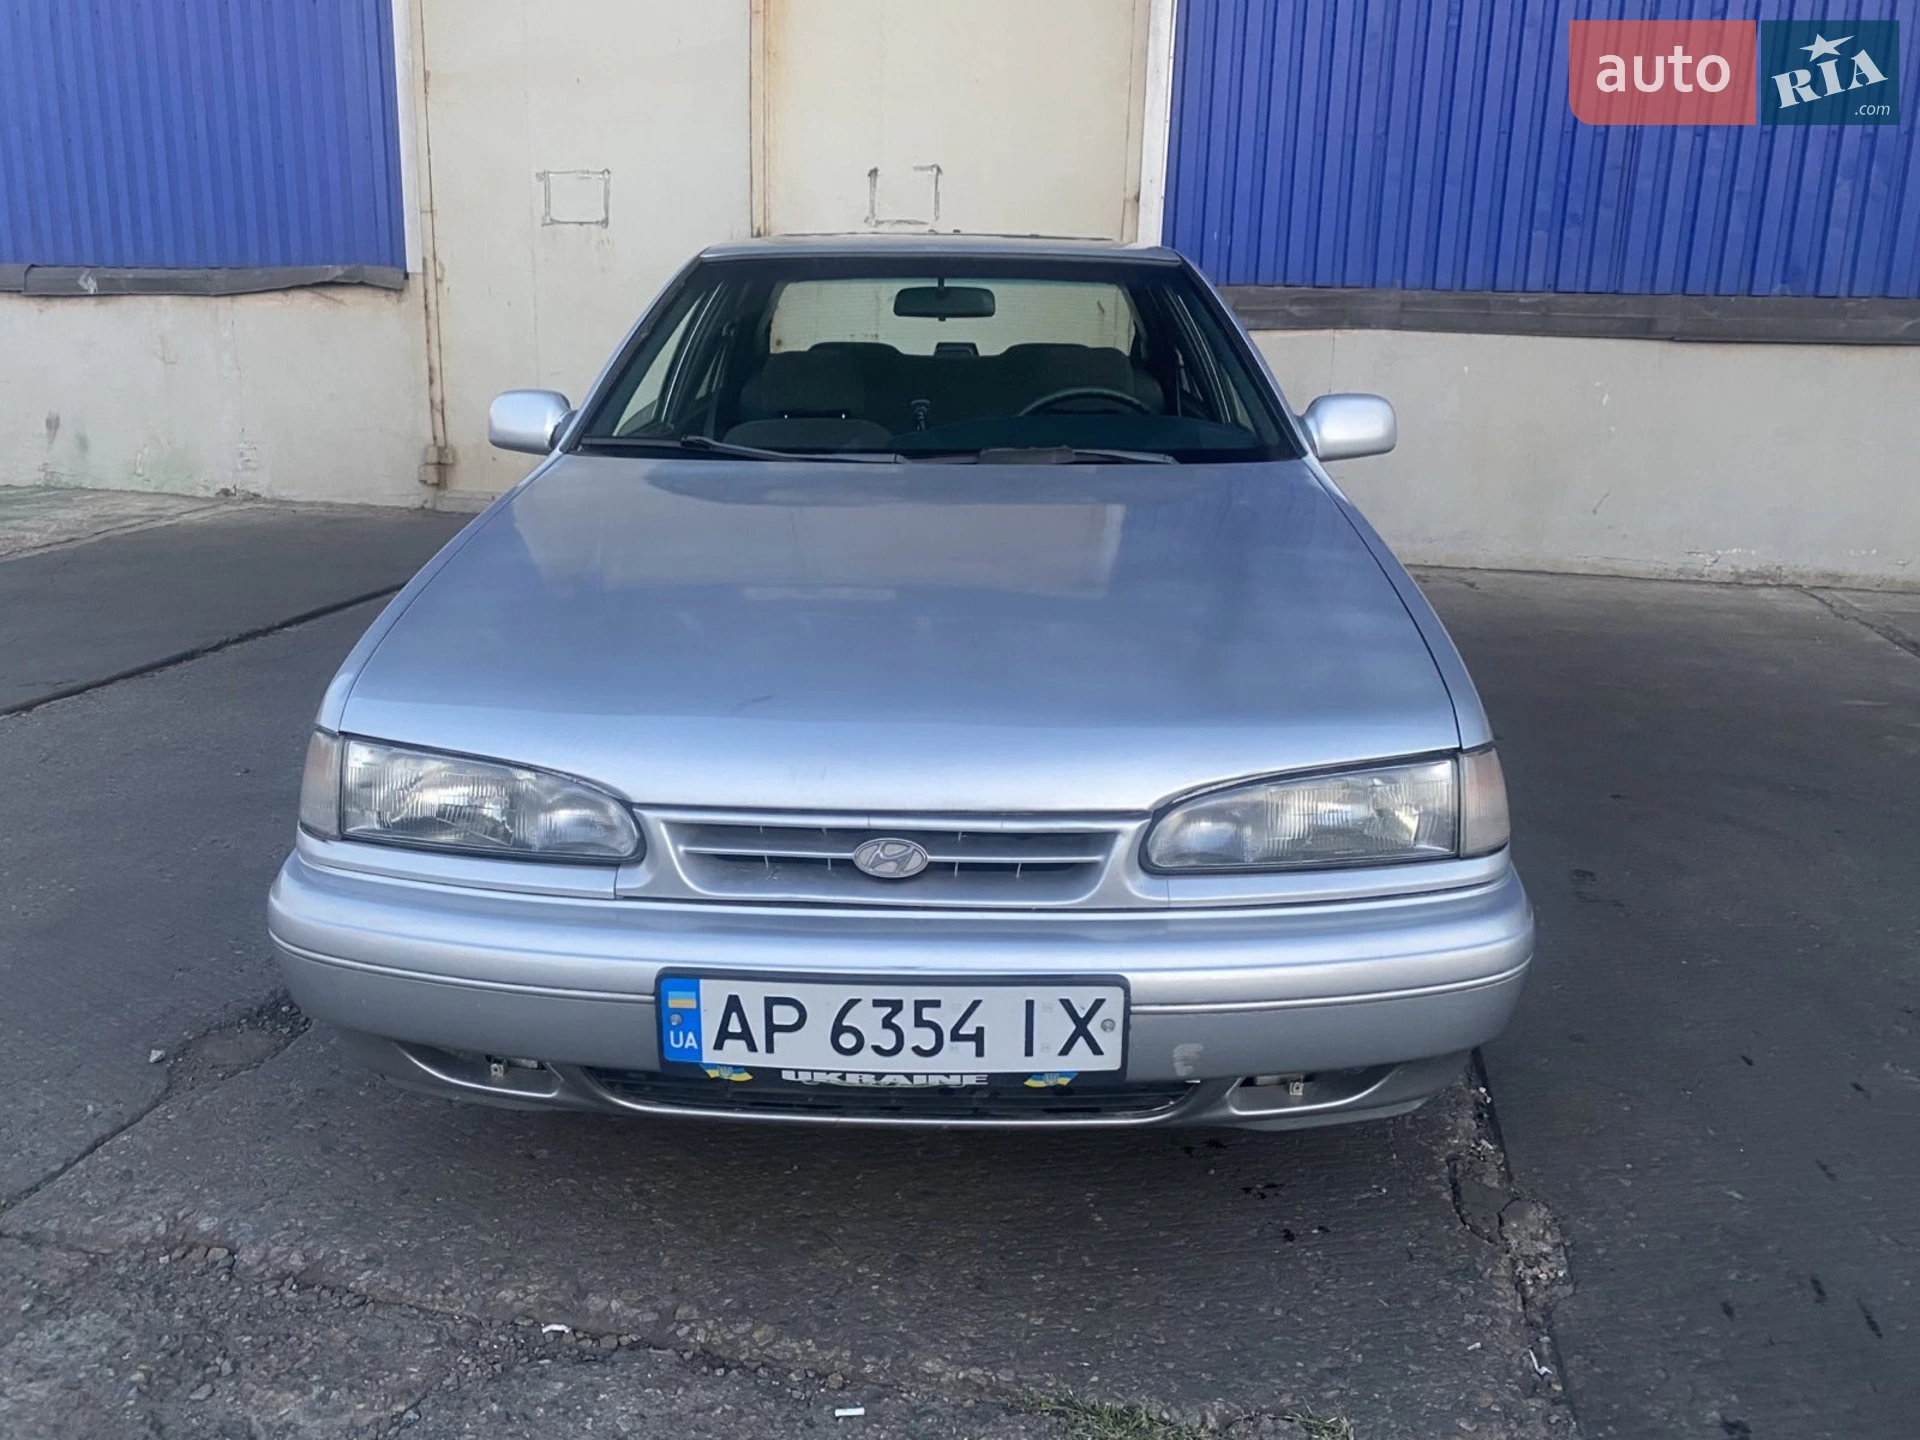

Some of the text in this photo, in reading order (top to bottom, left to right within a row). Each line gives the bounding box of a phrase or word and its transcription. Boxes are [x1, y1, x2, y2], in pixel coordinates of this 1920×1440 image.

[712, 994, 807, 1055] AP
[829, 998, 985, 1058] 6354
[670, 1030, 699, 1049] UA
[781, 1069, 988, 1087] UKRAINE
